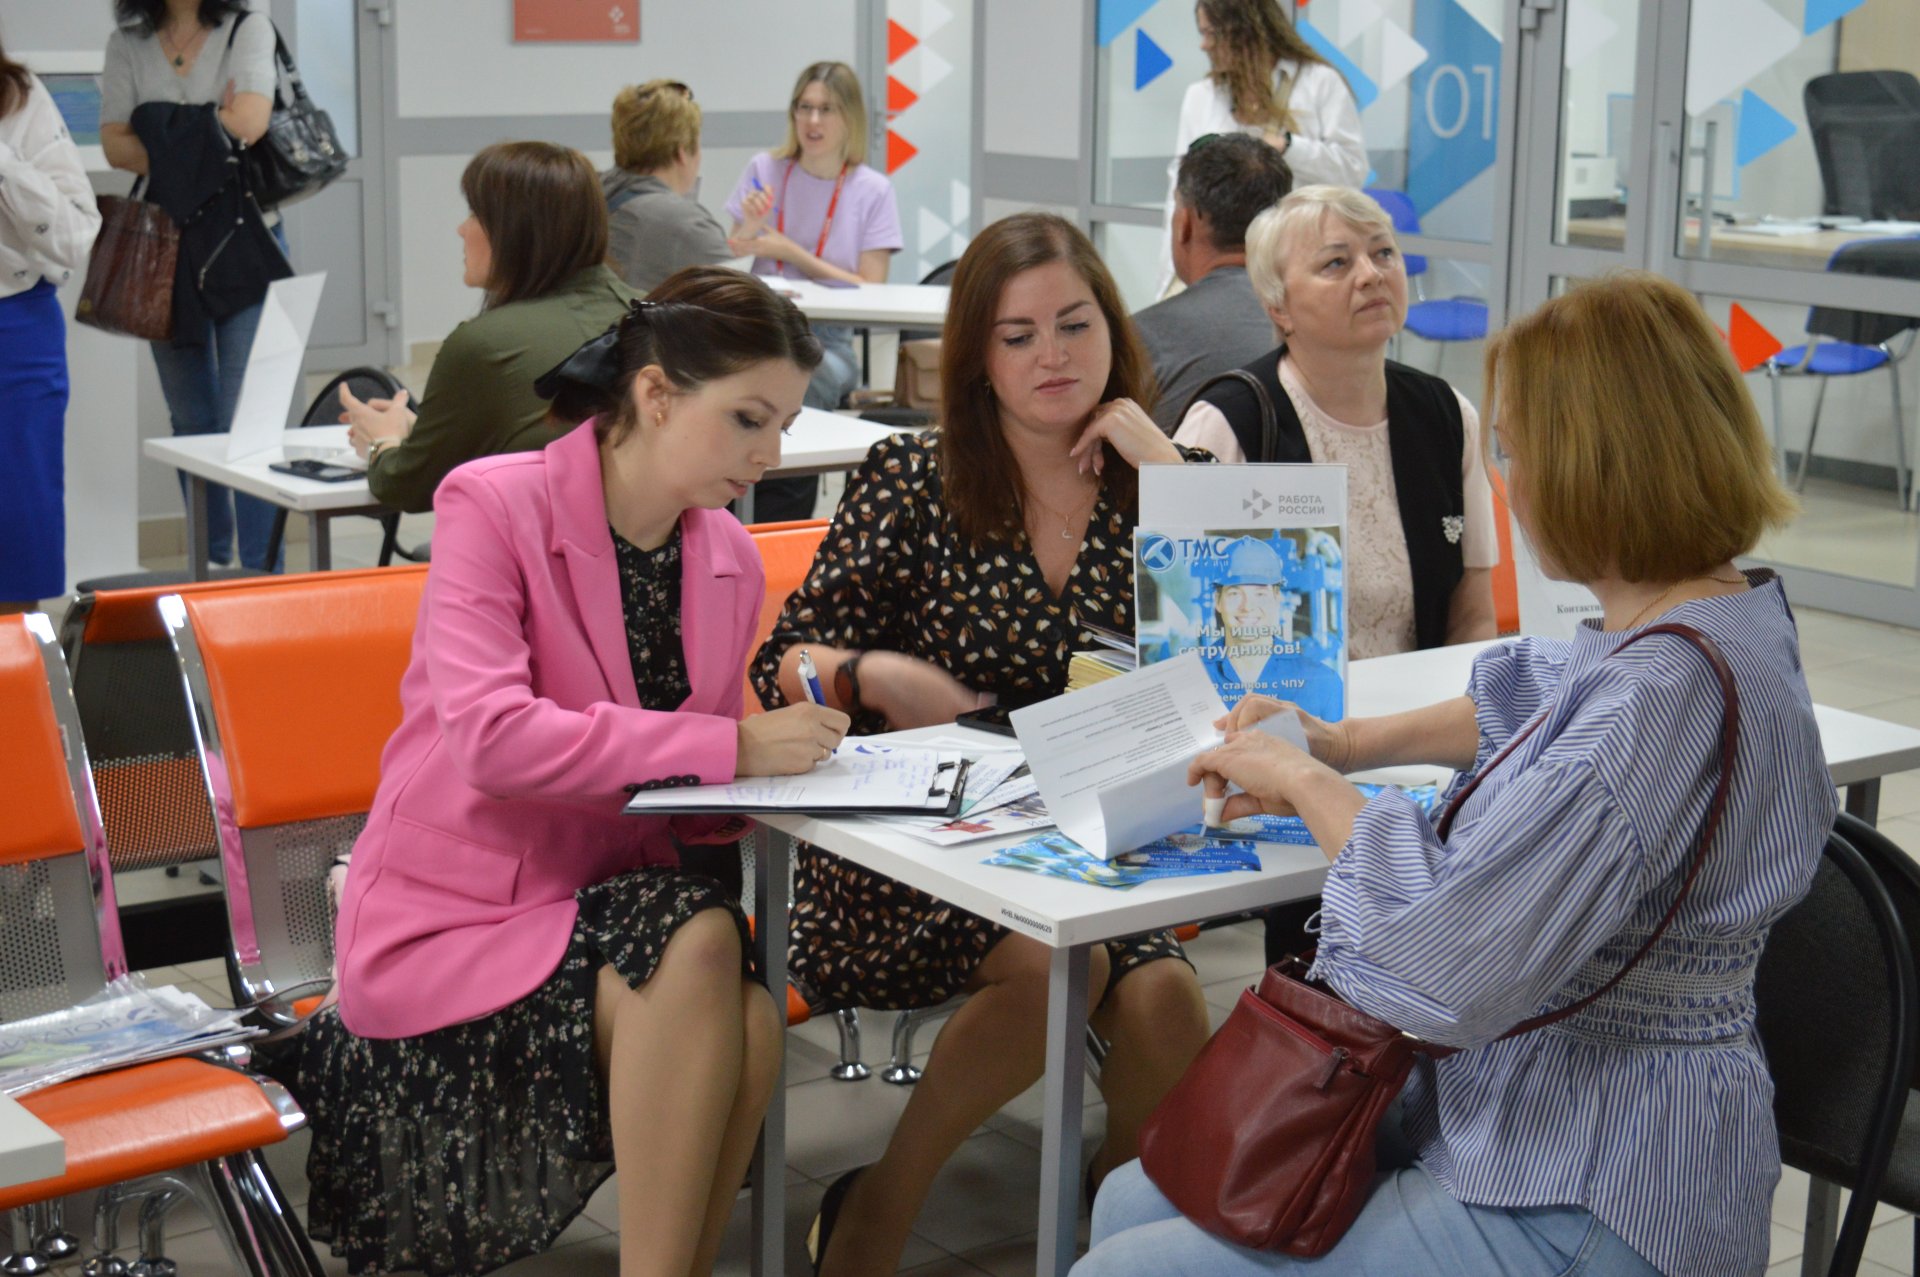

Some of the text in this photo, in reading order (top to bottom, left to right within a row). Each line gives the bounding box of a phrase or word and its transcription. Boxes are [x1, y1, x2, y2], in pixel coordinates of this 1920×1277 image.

[1425, 64, 1493, 140] 01
[1278, 495, 1322, 504] РАБОТА
[1278, 505, 1325, 515] РОССИИ
[1198, 624, 1283, 640] Мы ищем
[1280, 678, 1305, 688] ЧПУ
